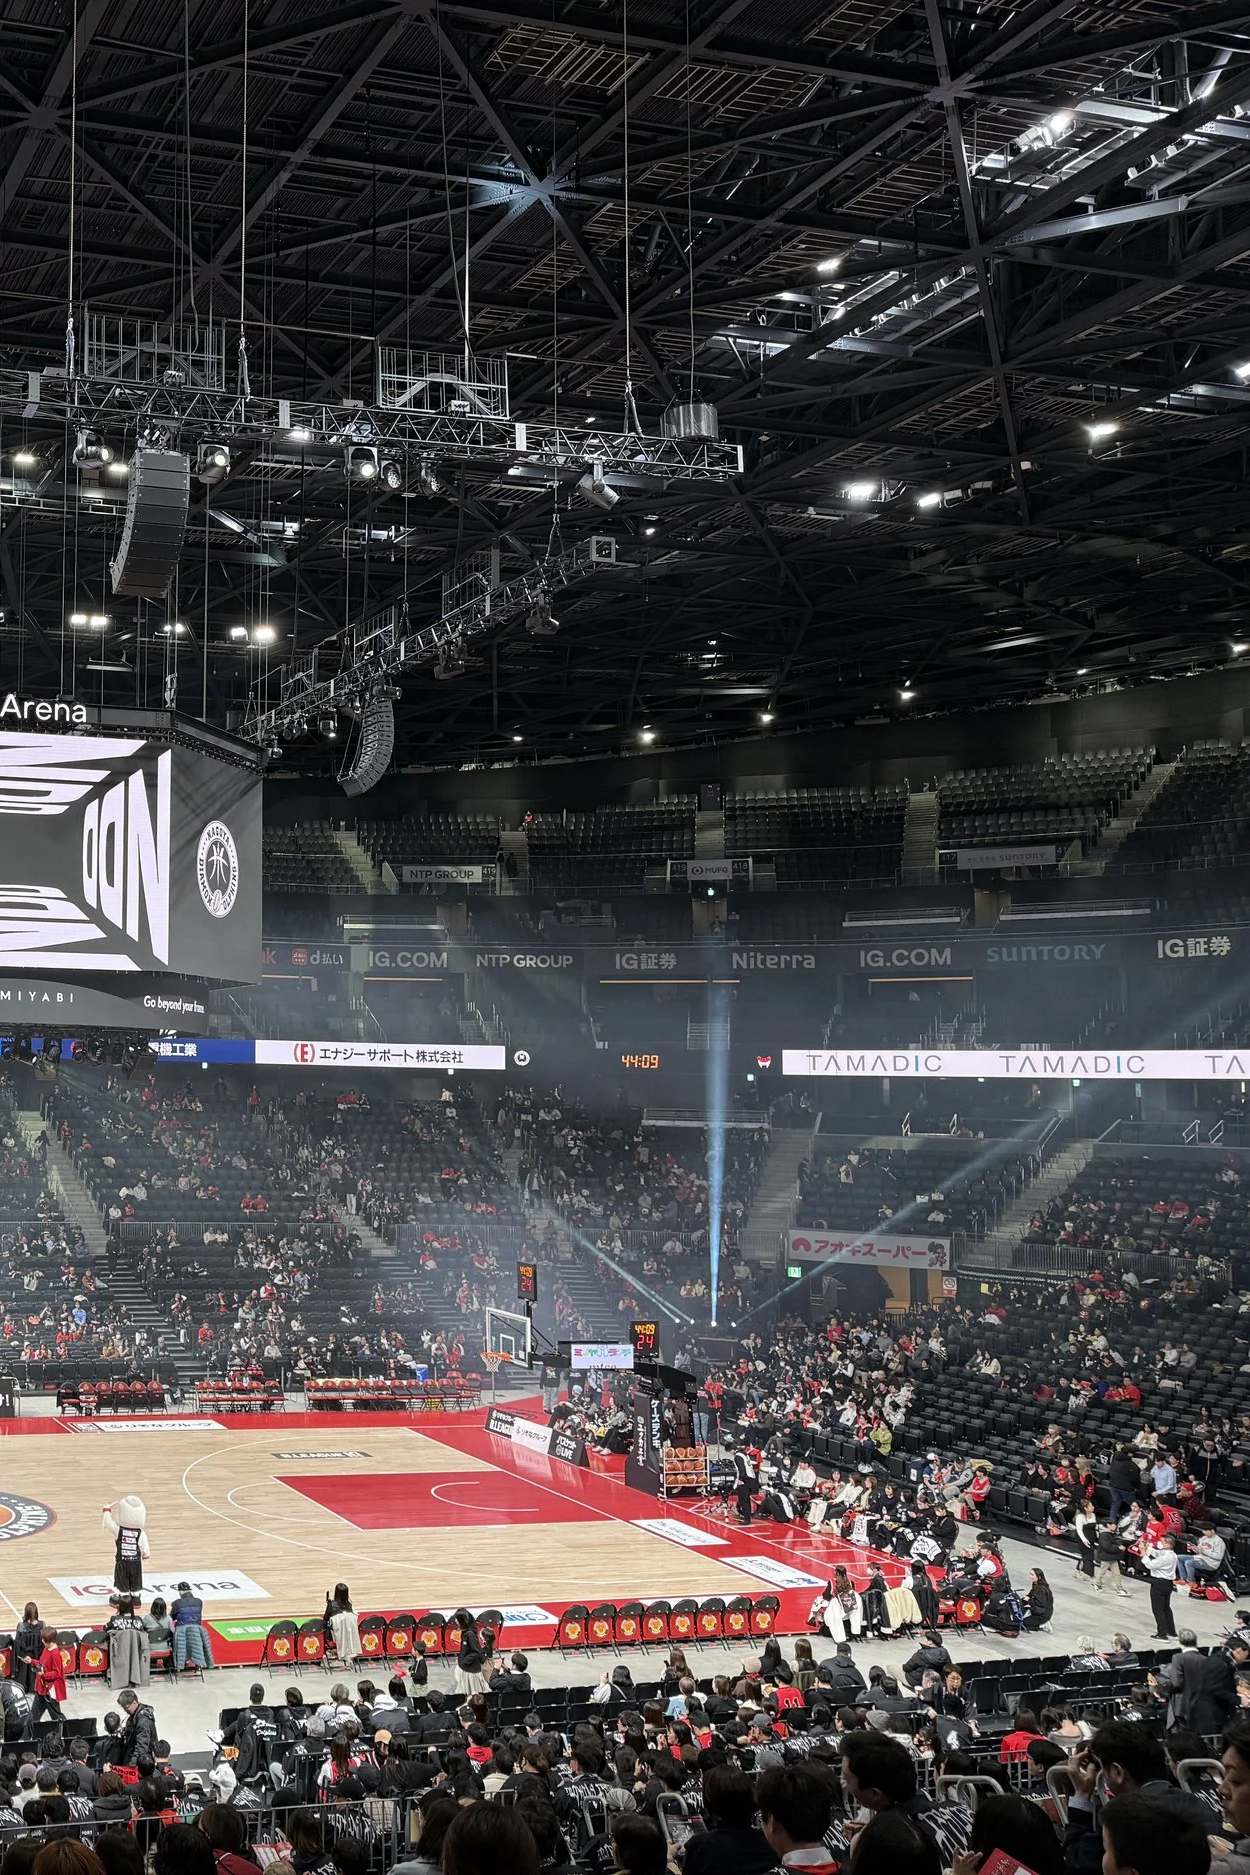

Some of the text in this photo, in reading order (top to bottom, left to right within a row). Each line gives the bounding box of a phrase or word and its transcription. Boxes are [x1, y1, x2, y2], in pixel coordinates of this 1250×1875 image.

[0, 694, 88, 723] Arena
[410, 870, 433, 879] NTP
[435, 870, 474, 879] GROUP
[733, 862, 748, 870] 418
[986, 943, 1107, 962] SUNTORY
[1157, 935, 1232, 959] IG証券
[369, 951, 448, 968] IG.COM
[476, 954, 574, 969] NTP GROUP
[615, 952, 678, 970] IG証券
[732, 951, 816, 969] Niterra
[860, 947, 952, 967] IG.COM
[0, 990, 74, 1003] MIYABI
[143, 996, 156, 1008] Go
[157, 996, 182, 1012] beyond
[182, 1001, 194, 1014] your
[319, 1047, 464, 1064] エナジーサポート株式会社
[621, 1054, 659, 1069] 44:09
[806, 1054, 943, 1072] TAMADIC
[1000, 1055, 1145, 1073] TAMADIC
[814, 1239, 927, 1260] アオキスーパー
[521, 1277, 532, 1291] 24
[634, 1324, 655, 1335] 44:09
[637, 1335, 654, 1350] 24
[651, 1399, 661, 1448] ケーズデンキ
[561, 1447, 574, 1459] LIVE
[70, 1584, 115, 1597] IG
